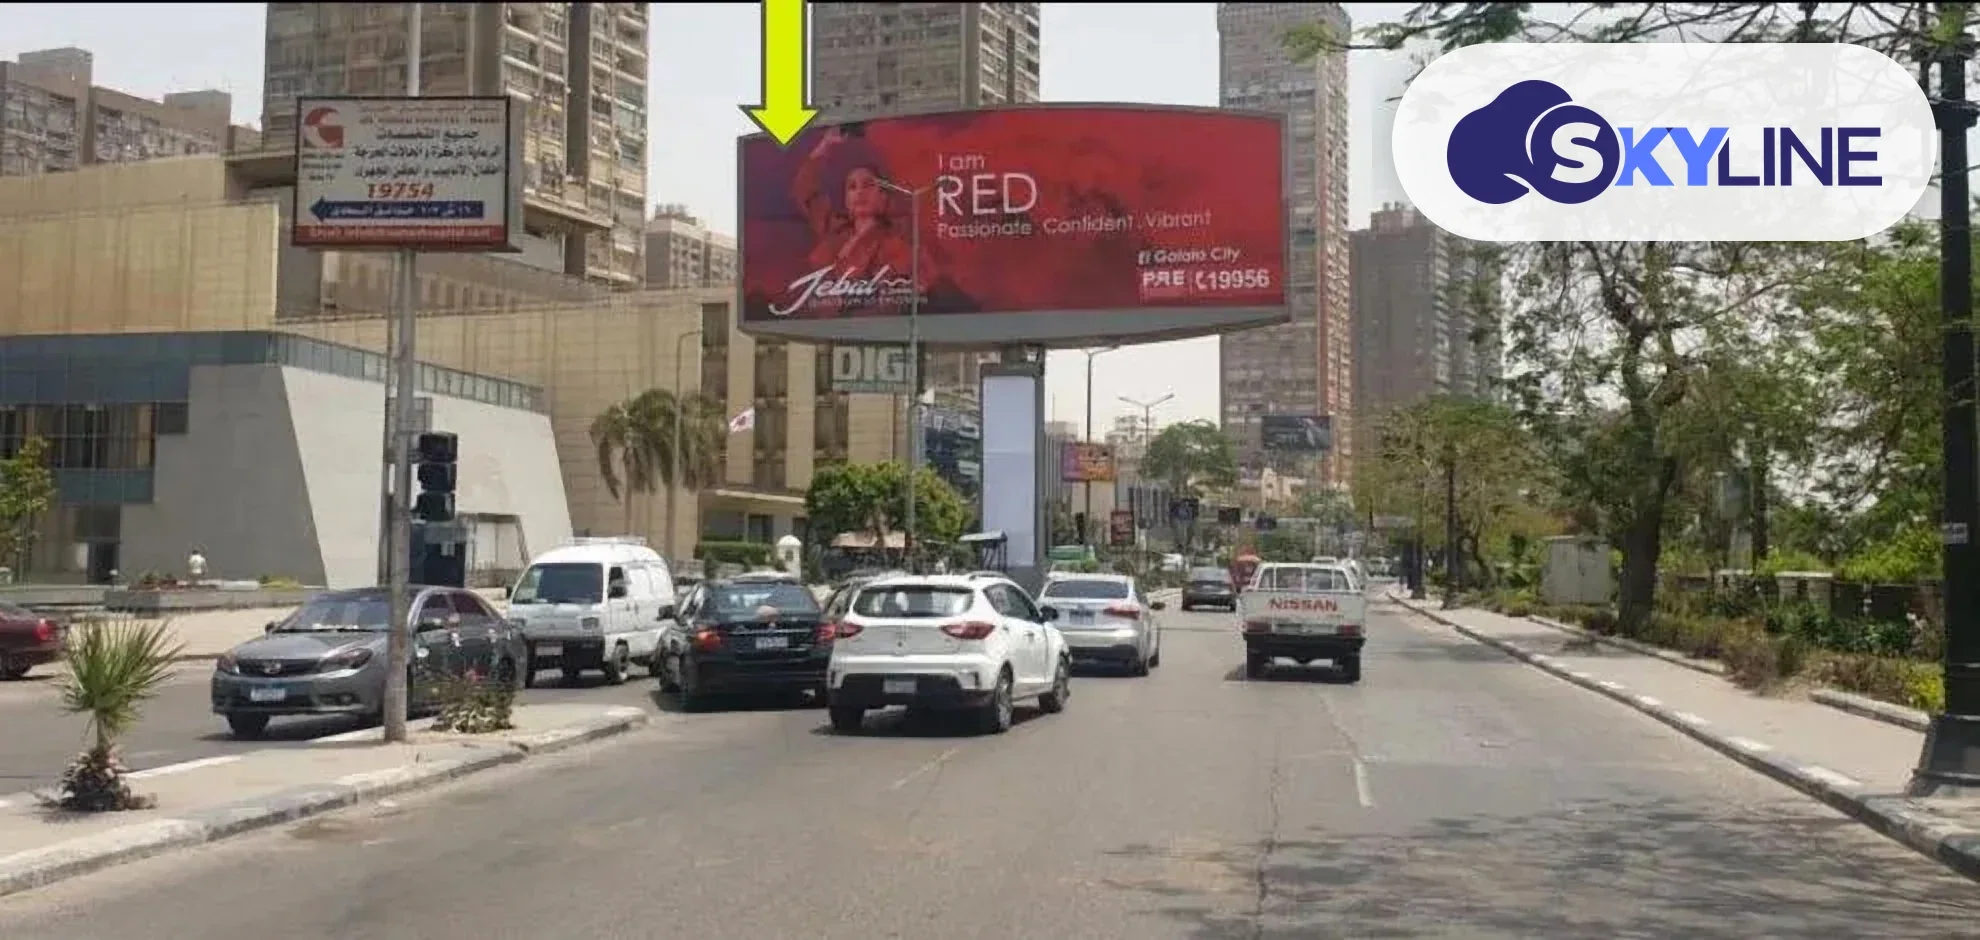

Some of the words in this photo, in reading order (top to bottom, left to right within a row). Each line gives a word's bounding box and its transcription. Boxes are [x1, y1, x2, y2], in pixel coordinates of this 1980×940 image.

[938, 153, 943, 171] I
[949, 154, 985, 170] am
[368, 183, 434, 198] 19754
[938, 173, 1037, 216] RED
[938, 220, 1032, 238] Passionate
[1210, 246, 1241, 263] City
[1206, 268, 1271, 290] 19956
[1269, 598, 1338, 612] NISSAN
